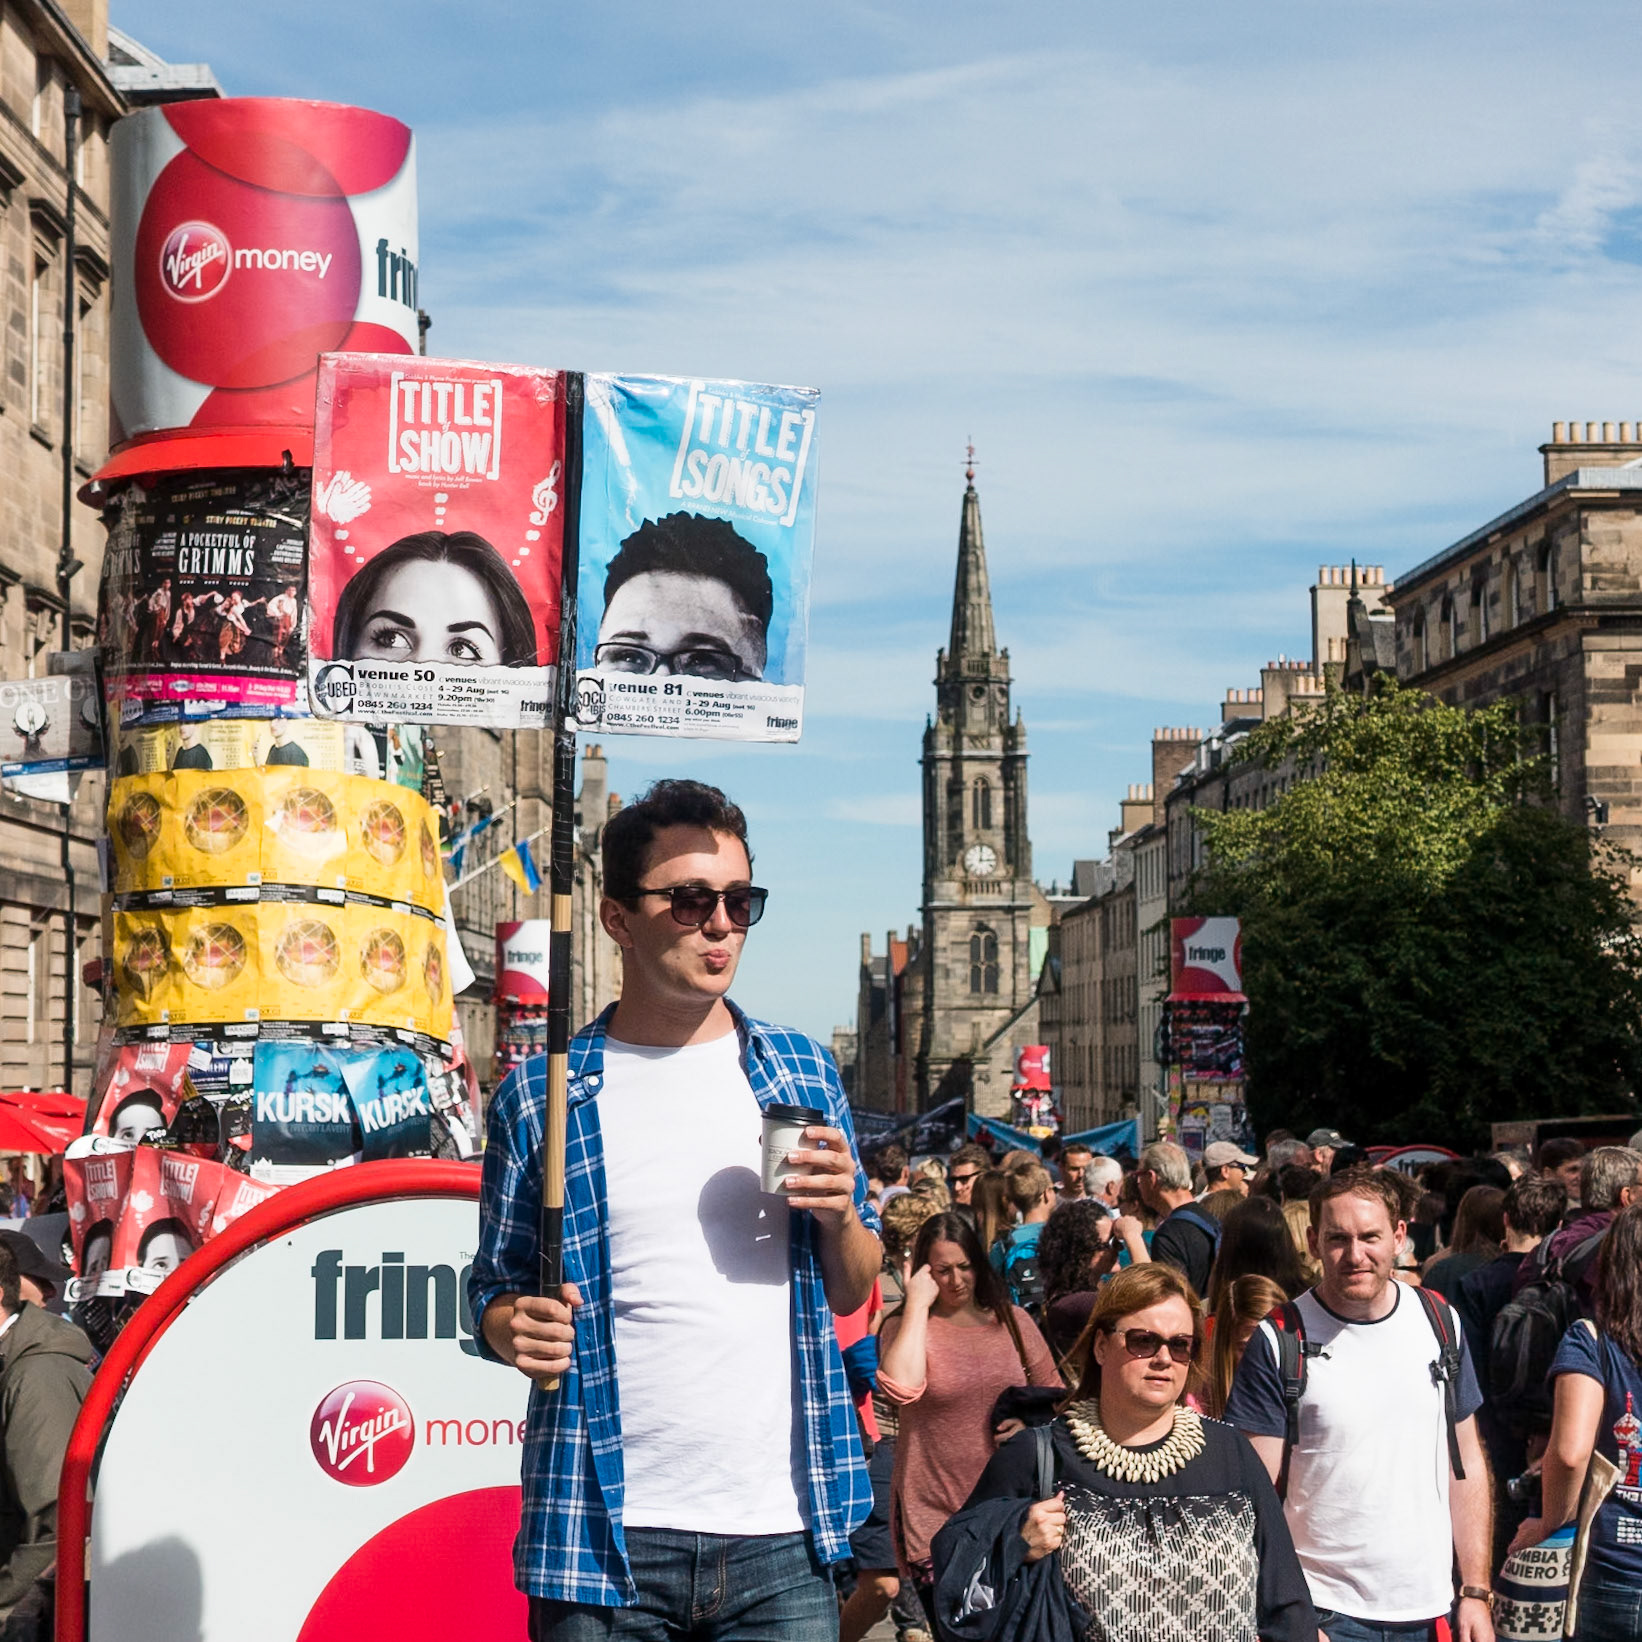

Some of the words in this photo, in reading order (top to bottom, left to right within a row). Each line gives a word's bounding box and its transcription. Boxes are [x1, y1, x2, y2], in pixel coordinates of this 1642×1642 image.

[166, 233, 224, 289] Virgin
[235, 248, 333, 279] money
[400, 381, 493, 427] TITLE
[698, 393, 802, 463] TITLE
[400, 429, 493, 475] SHOW
[681, 449, 792, 515] SONGS
[180, 532, 186, 546] A
[188, 532, 240, 549] POCKETFUL
[242, 534, 256, 549] OF
[178, 547, 255, 576] GRIMMS
[357, 669, 409, 681] venue
[413, 669, 435, 682] 50
[445, 676, 477, 684] venues
[452, 685, 463, 693] 29
[466, 685, 485, 695] Aug
[609, 683, 658, 694] venue
[664, 683, 683, 696] 81
[693, 691, 725, 699] venues
[357, 700, 384, 709] 0845
[387, 700, 407, 710] 260
[410, 701, 433, 711] 1234
[437, 694, 473, 704] 9.20pm
[520, 699, 553, 715] fringe
[712, 700, 731, 710] Aug
[606, 713, 633, 722] 0845
[635, 714, 655, 723] 260
[657, 716, 680, 724] 1234
[685, 708, 720, 718] 6.00pm
[766, 715, 798, 730] fringe
[507, 950, 543, 965] fringe
[1188, 946, 1226, 963] fringe
[256, 1091, 351, 1124] KURSK
[358, 1086, 429, 1134] KURSK
[87, 1163, 115, 1181] TITLE
[164, 1160, 197, 1182] TITLE
[89, 1182, 117, 1201] SHOW
[164, 1178, 193, 1203] SHOW
[318, 1391, 409, 1474] Virgin
